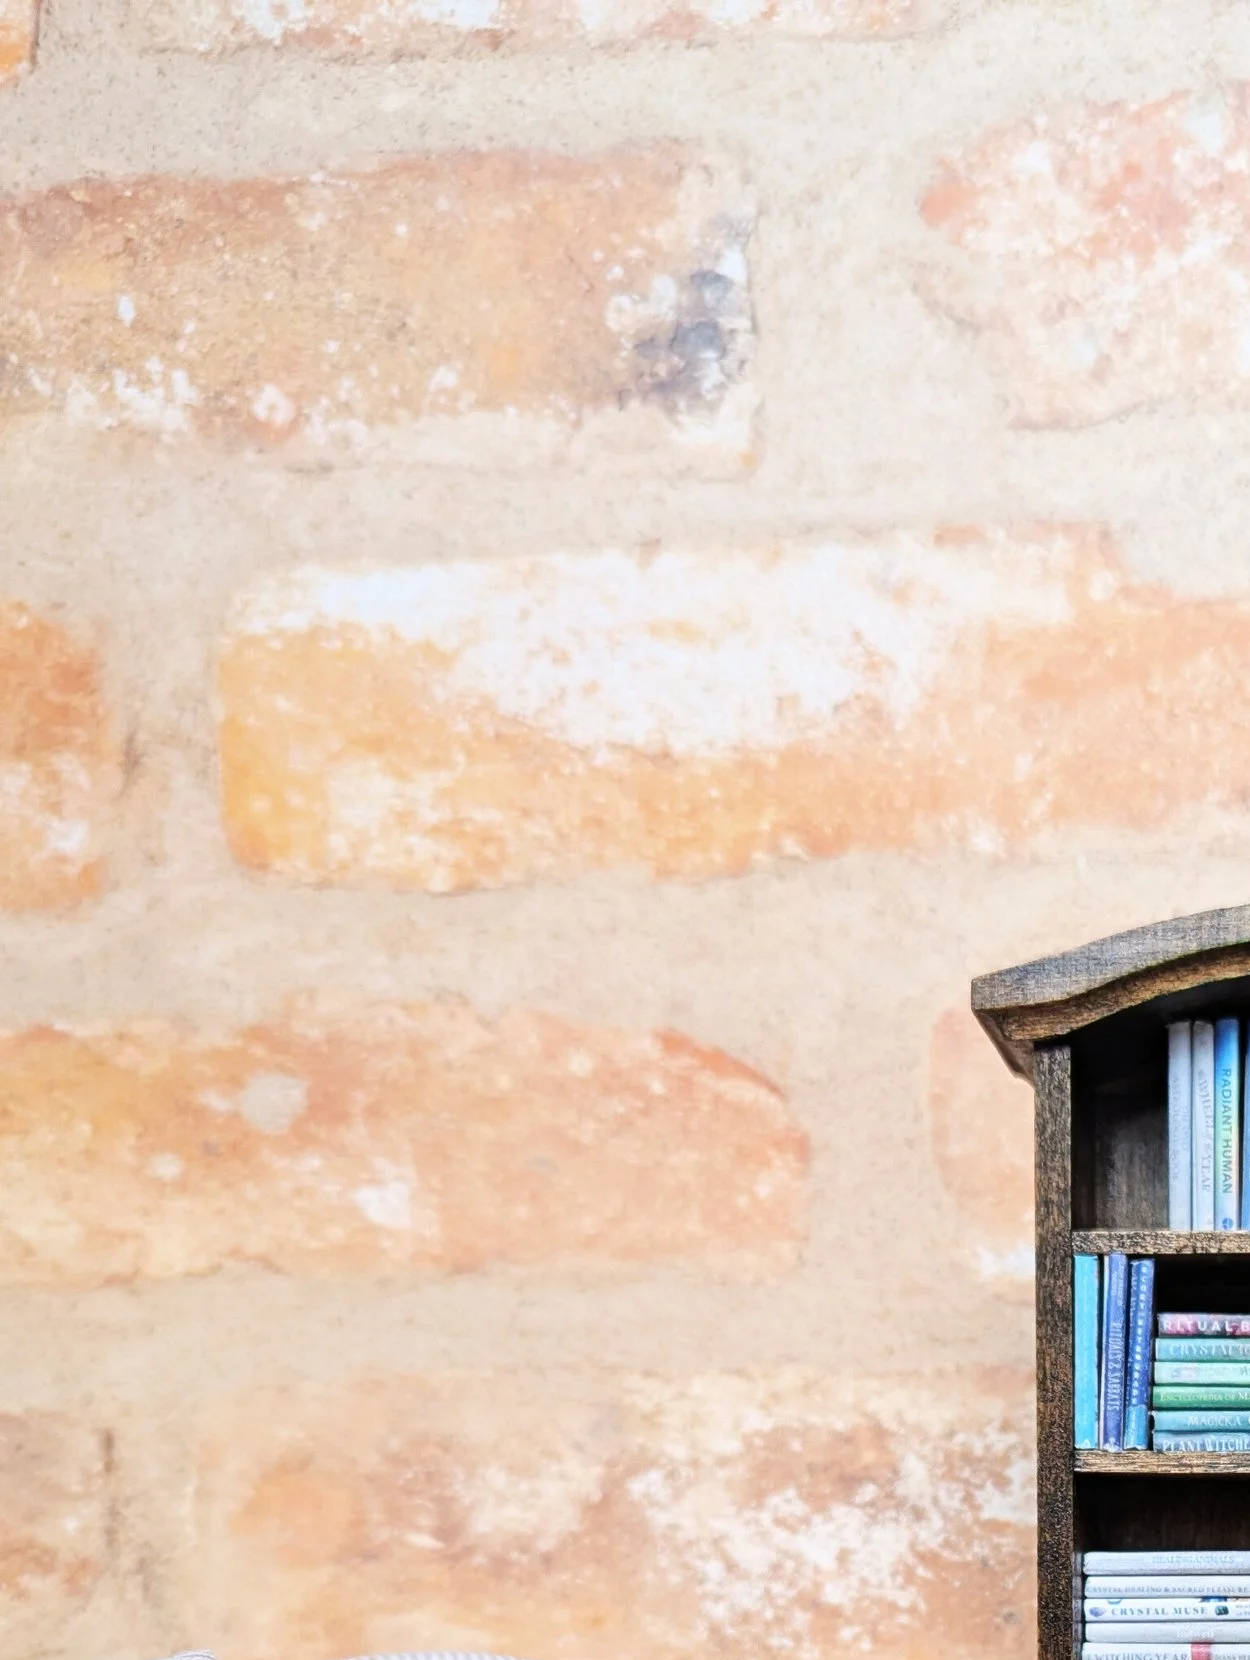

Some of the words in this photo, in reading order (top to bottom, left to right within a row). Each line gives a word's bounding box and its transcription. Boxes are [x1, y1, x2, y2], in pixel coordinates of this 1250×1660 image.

[1221, 1068, 1233, 1133] RADIANT
[1222, 1139, 1233, 1194] HUMAN
[1108, 1322, 1122, 1360] RITUALS
[1162, 1320, 1234, 1332] RITUAL
[1107, 1372, 1121, 1411] SABBATS
[1162, 1440, 1203, 1452] PLANT
[1111, 1607, 1168, 1616] CRYSTAL
[1173, 1607, 1208, 1615] MUSE
